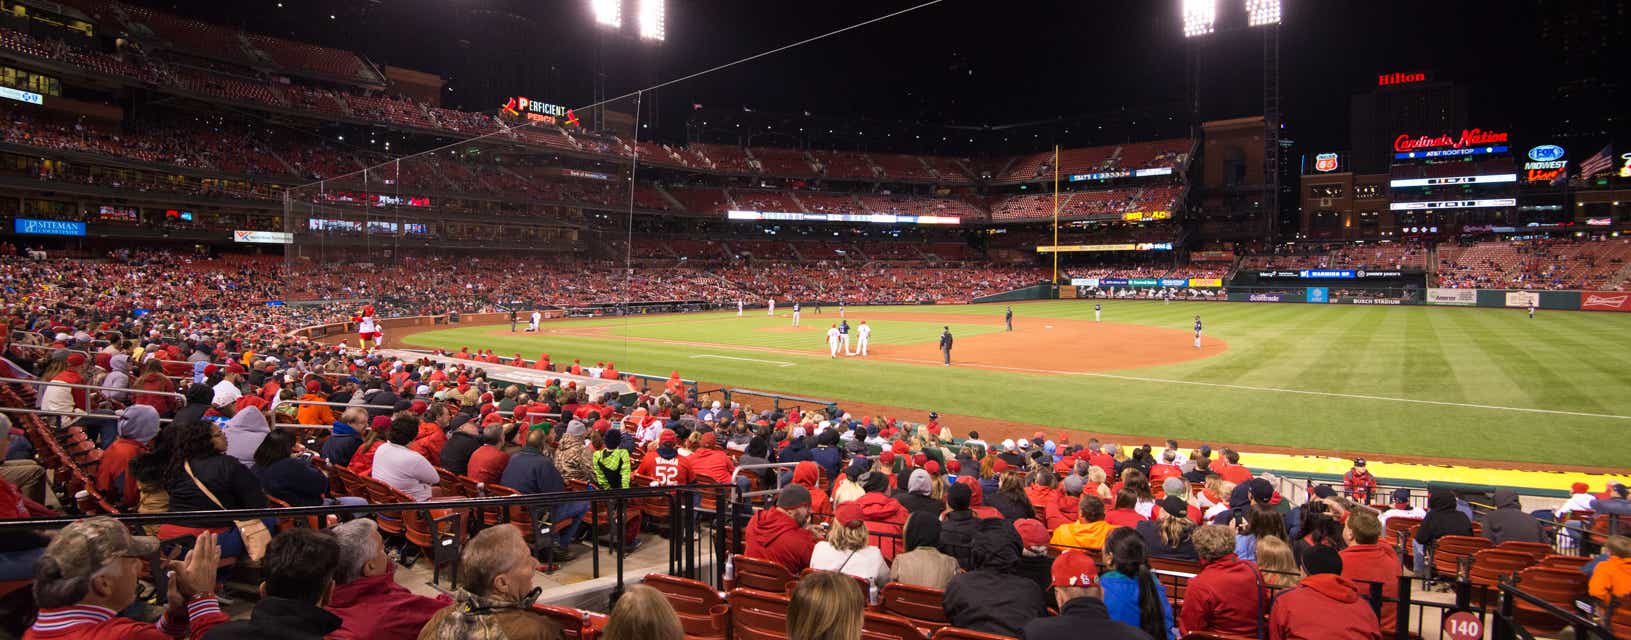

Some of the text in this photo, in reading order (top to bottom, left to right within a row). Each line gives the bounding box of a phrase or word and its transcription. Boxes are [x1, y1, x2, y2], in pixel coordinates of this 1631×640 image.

[1379, 71, 1425, 85] Hilton
[518, 96, 566, 117] PERFICIENT
[1394, 128, 1508, 152] Cardinals Nation
[1536, 148, 1559, 158] FOX
[1525, 161, 1568, 170] MIDWEST
[38, 221, 79, 230] SITEMAN
[656, 466, 678, 486] 52
[1451, 619, 1479, 637] 140
